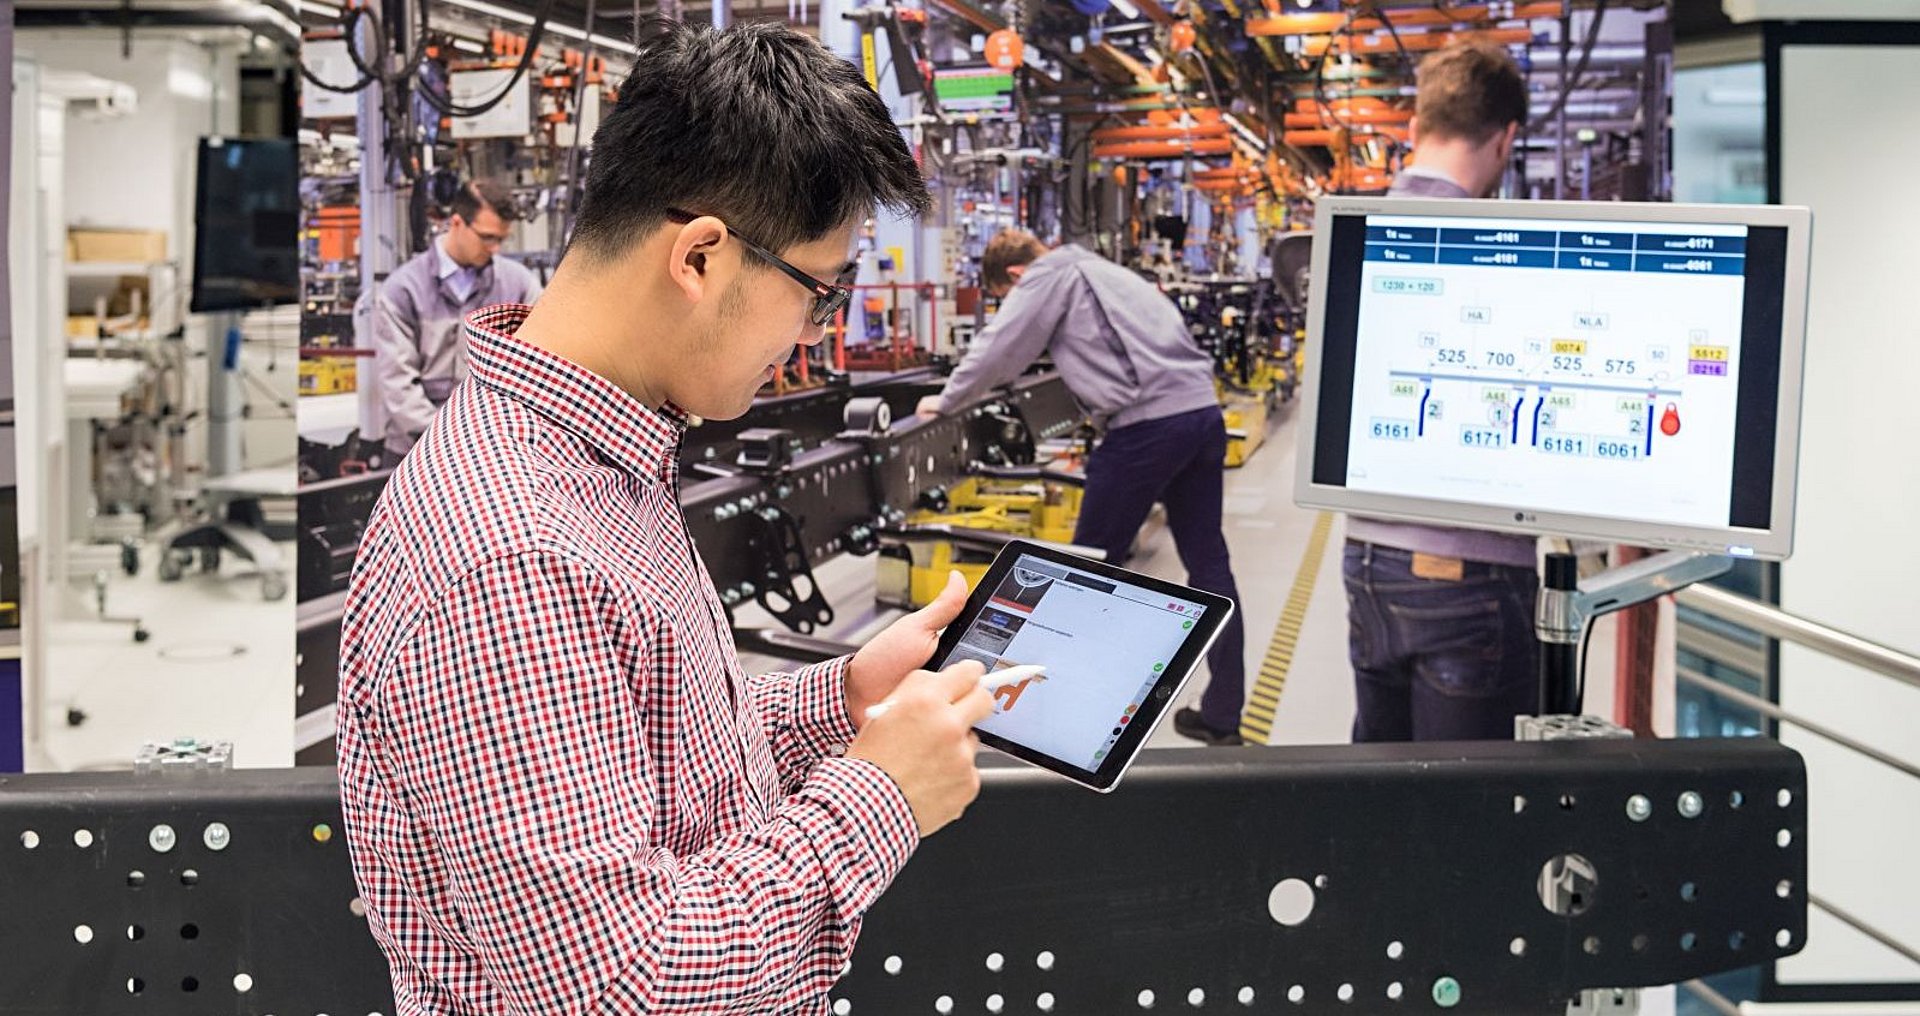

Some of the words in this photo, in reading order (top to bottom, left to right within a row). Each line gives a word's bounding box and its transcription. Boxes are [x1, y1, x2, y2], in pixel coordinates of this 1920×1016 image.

[1467, 311, 1483, 320] HA
[1579, 317, 1603, 327] NLA
[1555, 342, 1582, 353] 0074
[1437, 349, 1466, 363] 525
[1486, 351, 1515, 367] 700
[1552, 356, 1583, 371] 525
[1605, 359, 1635, 374] 575
[1428, 404, 1439, 416] 2
[1541, 412, 1551, 426] 2
[1630, 419, 1640, 432] 2
[1373, 423, 1409, 438] 6161
[1463, 430, 1501, 446] 6171
[1544, 437, 1583, 453] 6181
[1598, 442, 1638, 458] 6061
